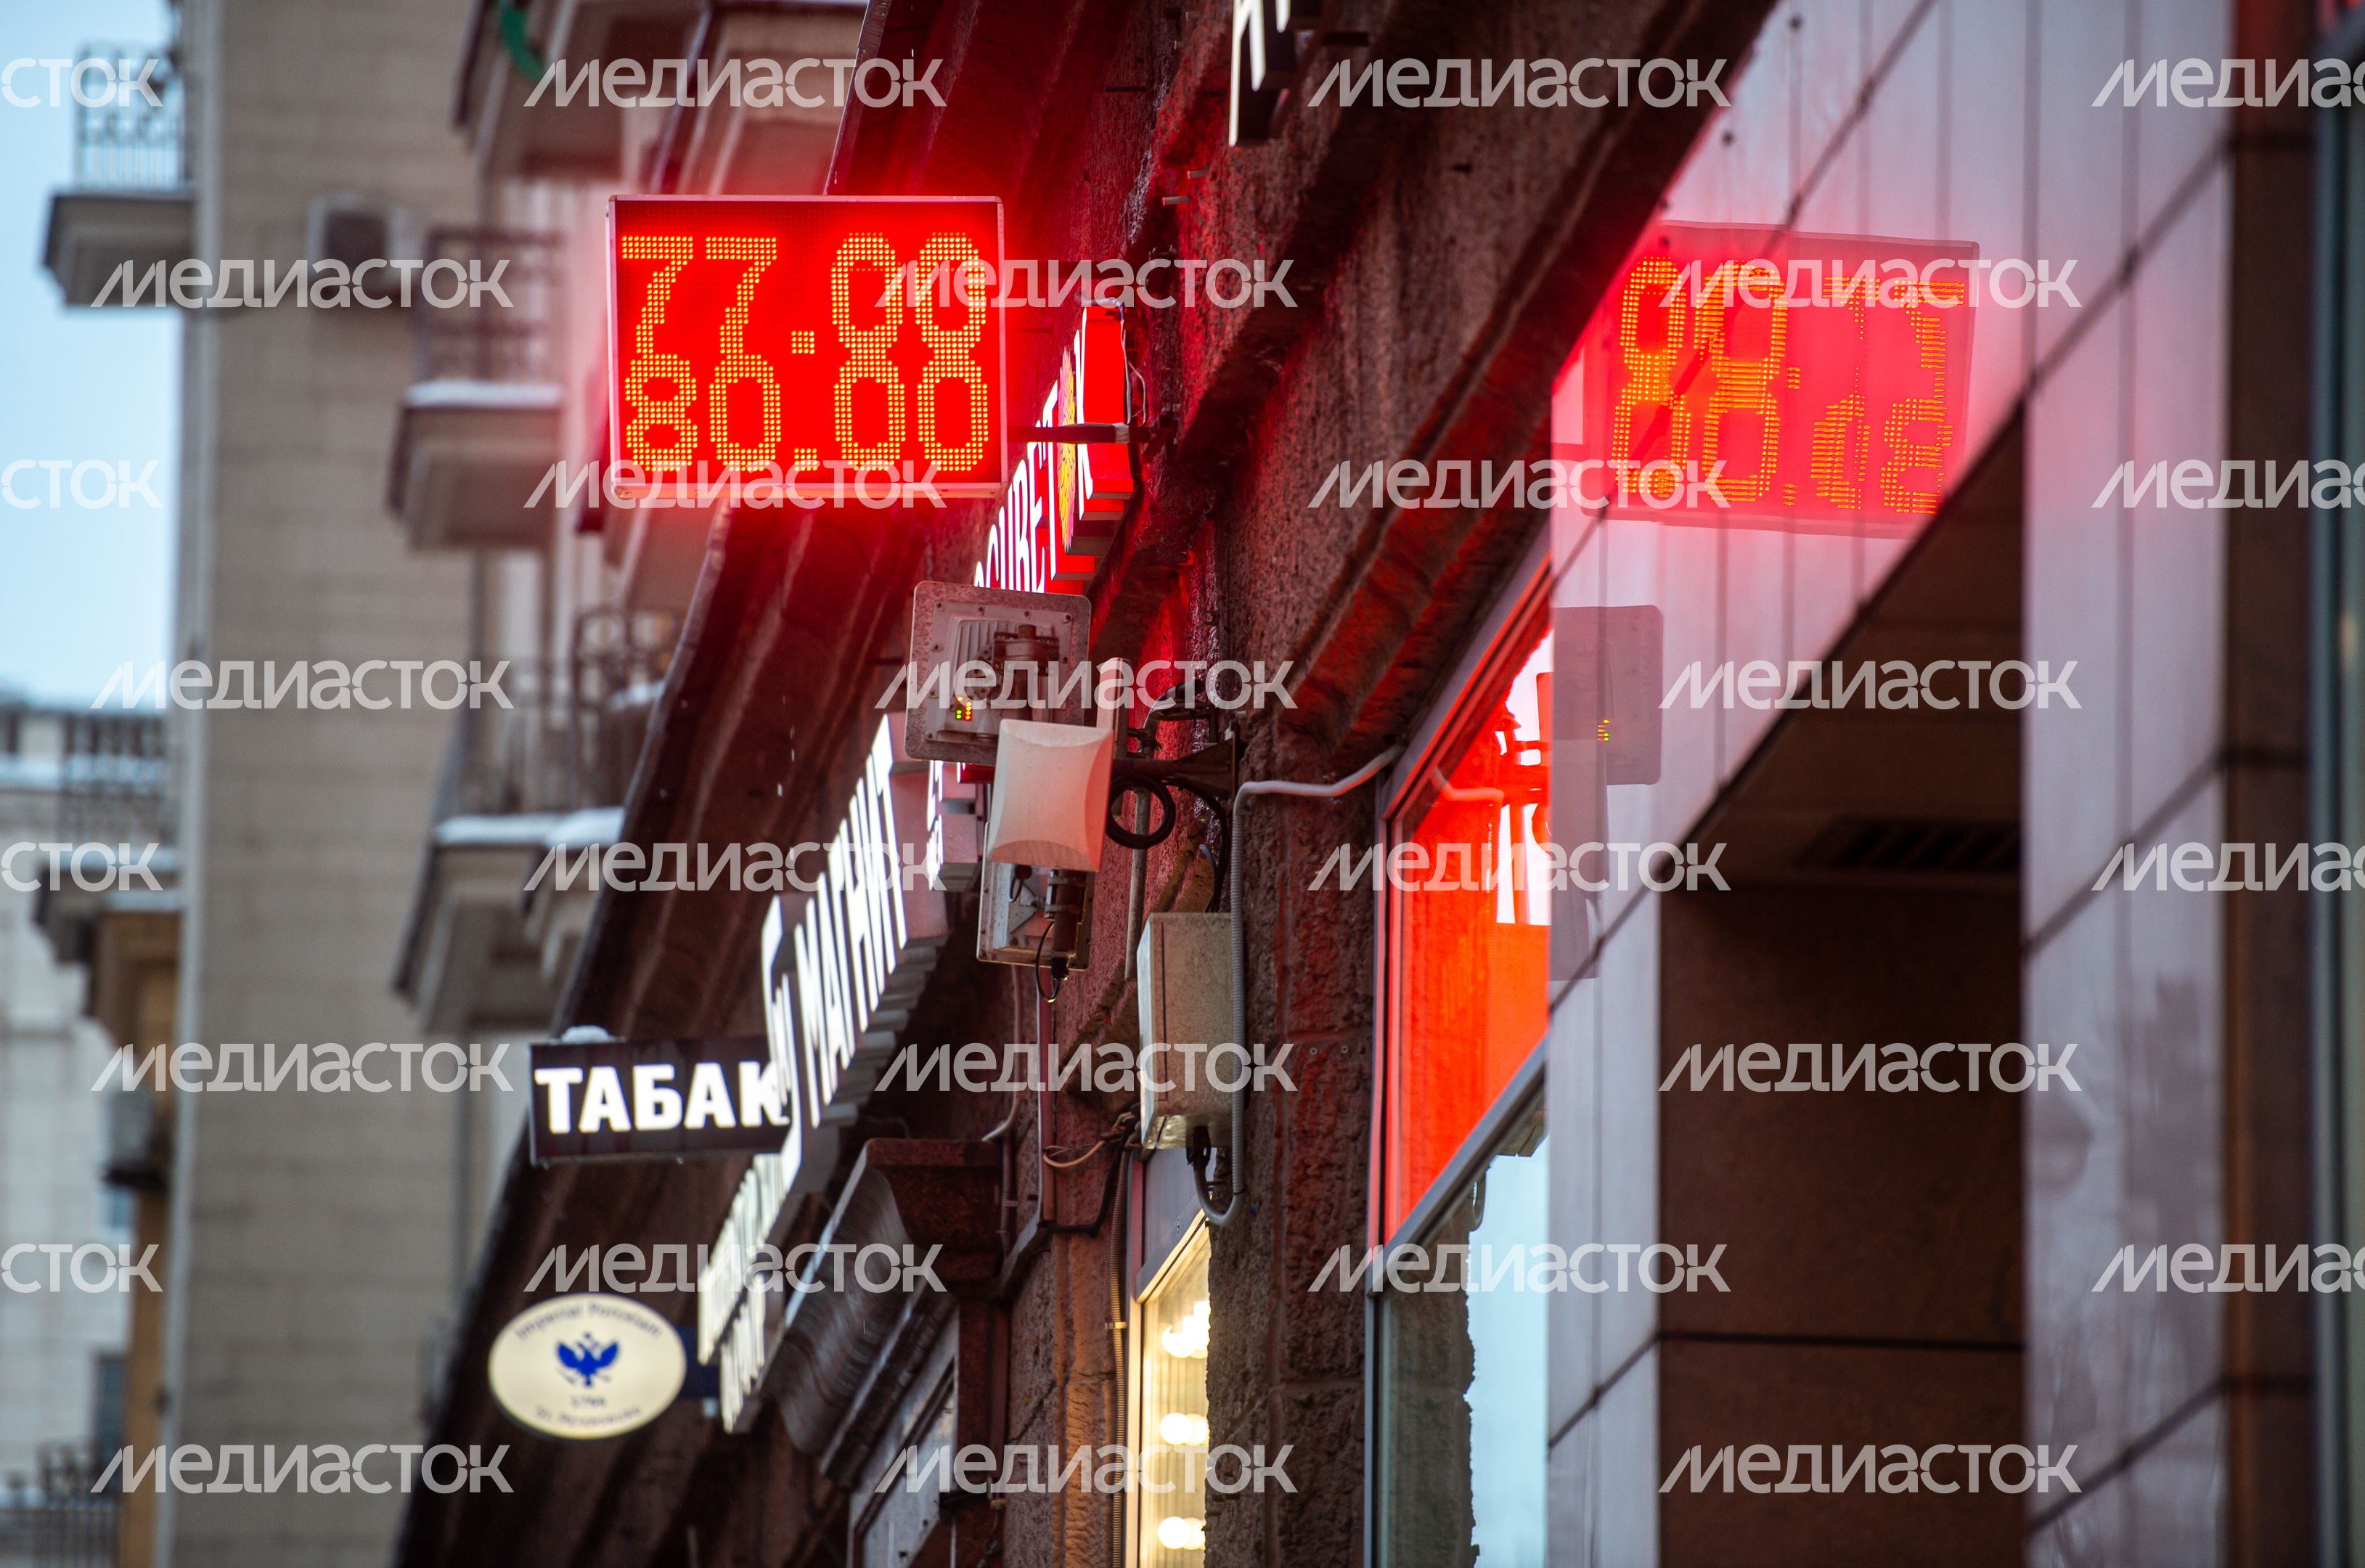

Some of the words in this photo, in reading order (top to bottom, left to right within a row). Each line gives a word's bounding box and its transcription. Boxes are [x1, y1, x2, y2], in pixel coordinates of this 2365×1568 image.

[625, 354, 989, 472] 80.00
[794, 714, 907, 1130] МАГНИТ
[534, 1060, 790, 1134] ТАБАК
